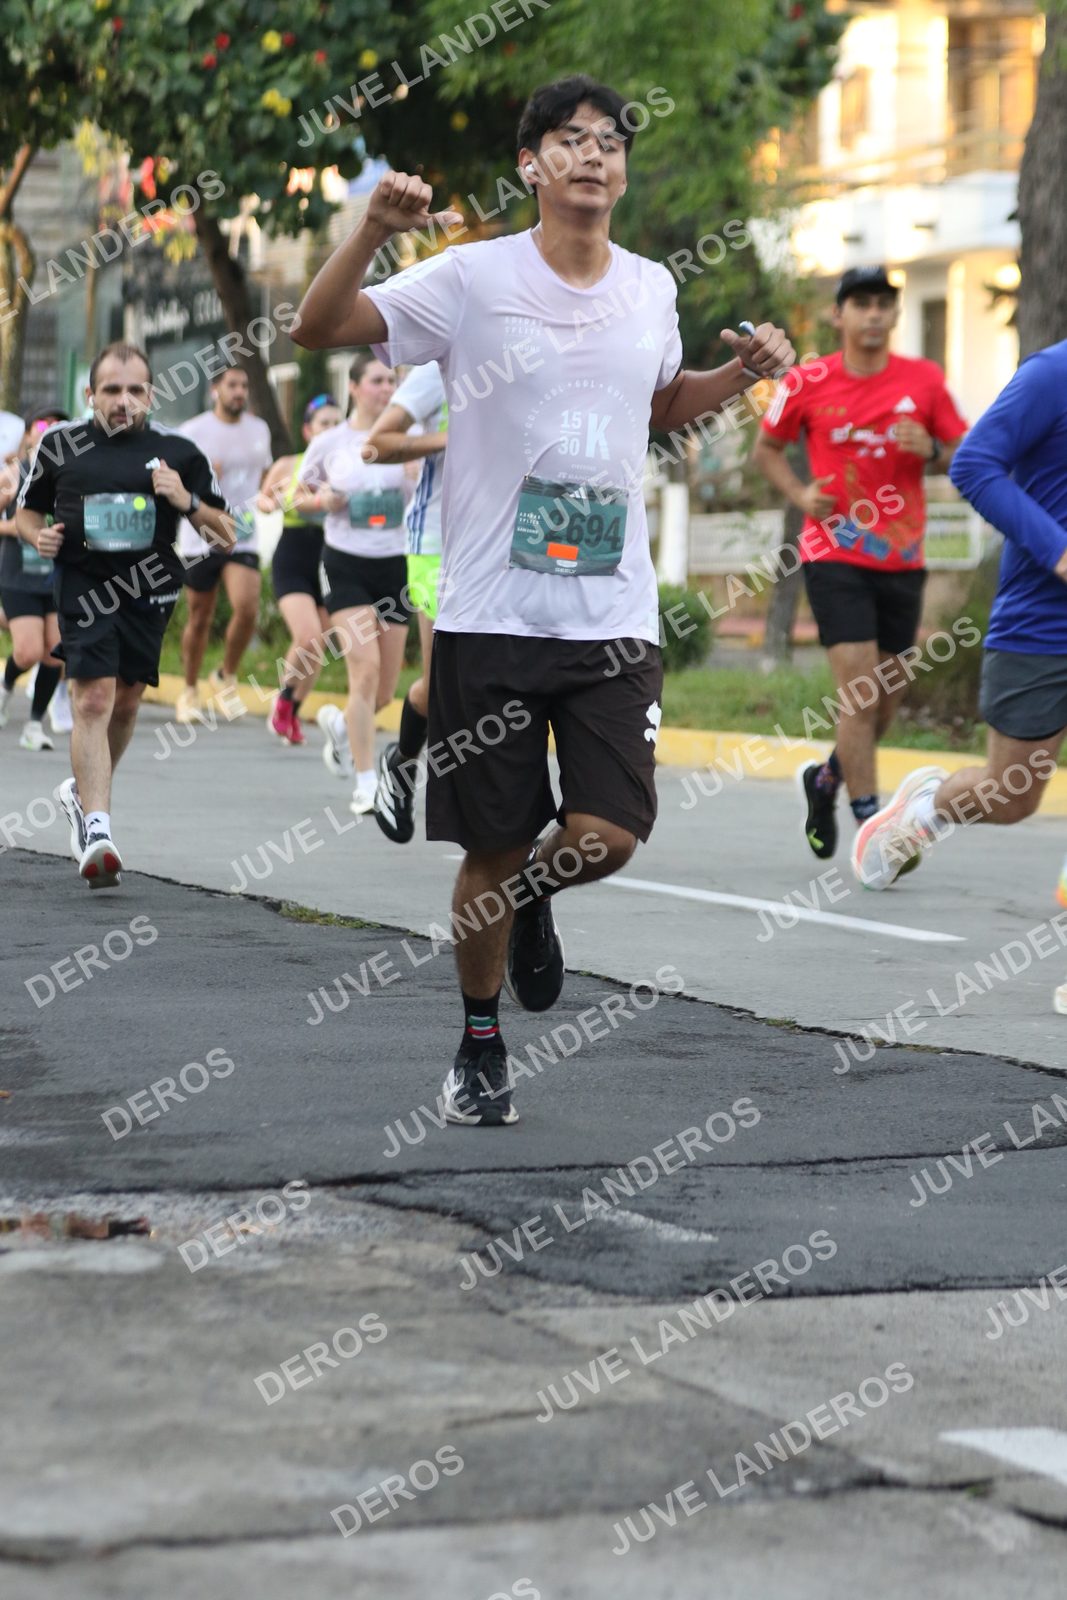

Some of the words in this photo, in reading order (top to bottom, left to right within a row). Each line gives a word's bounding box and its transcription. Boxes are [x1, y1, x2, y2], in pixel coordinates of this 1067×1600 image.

[561, 410, 582, 429] 15
[558, 436, 580, 456] 30
[585, 412, 612, 461] K
[103, 511, 153, 532] 1046
[544, 509, 621, 550] 2694
